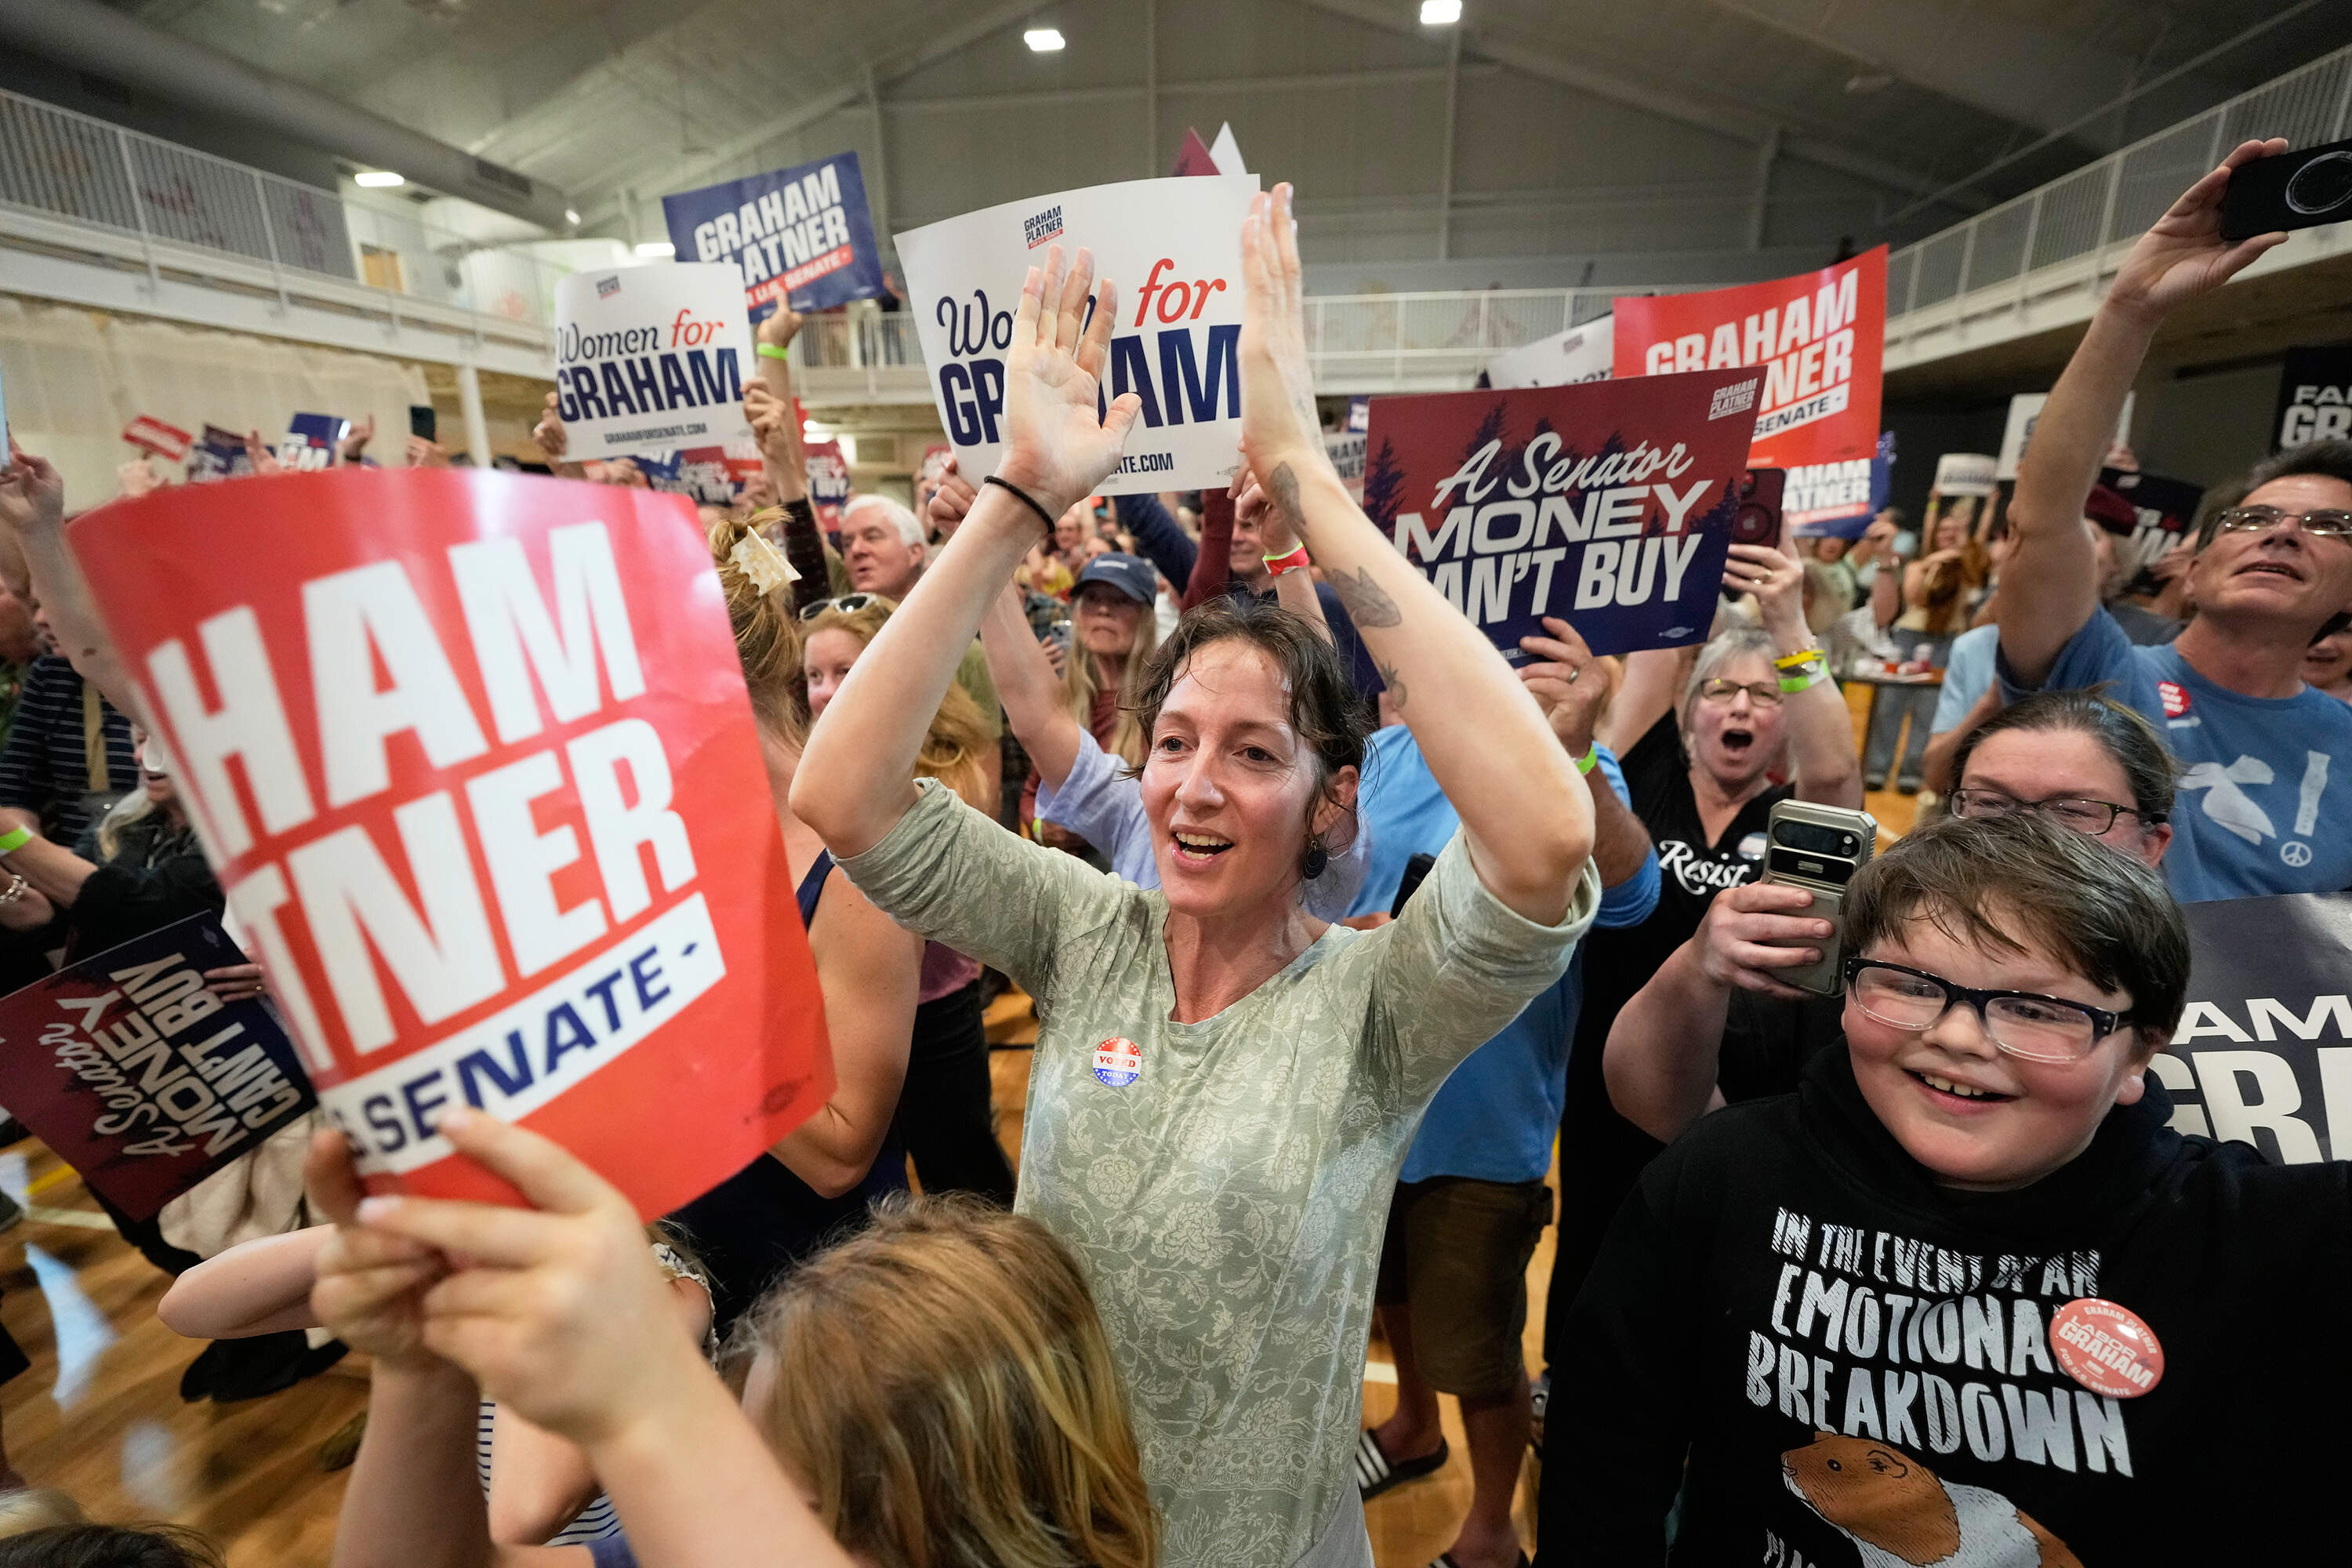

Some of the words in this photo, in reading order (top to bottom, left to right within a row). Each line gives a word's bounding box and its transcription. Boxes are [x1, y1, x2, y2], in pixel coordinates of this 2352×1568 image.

[694, 163, 841, 264] GRAHAM
[721, 205, 850, 287] ATNER
[1024, 205, 1062, 232] GRAHAM
[1026, 217, 1063, 243] PLATNER
[784, 251, 840, 290] SENATE
[1134, 258, 1226, 327] for
[557, 322, 659, 364] Women
[672, 308, 724, 348] for
[1646, 268, 1859, 376] GRAHAM
[557, 348, 743, 423] GRAHAM
[1710, 390, 1755, 413] PLATNER
[1712, 377, 1759, 401] GRAHAM
[1753, 394, 1830, 437] SENATE
[2293, 384, 2352, 405] FA
[1431, 438, 1503, 509] A
[1507, 431, 1694, 498] Senator
[1394, 480, 1714, 562] MONEY
[1573, 533, 1703, 609] BUY
[109, 952, 226, 1039] BUY
[38, 1023, 160, 1135] Senator
[56, 989, 249, 1157] MONEY
[177, 1021, 302, 1130] CAN'T
[363, 945, 672, 1155] SENATE
[1101, 1070, 1129, 1080] TODAY
[122, 1126, 198, 1157] A
[1771, 1206, 1812, 1261] IN
[1820, 1223, 1865, 1278] THE
[1874, 1231, 1984, 1294] EVENT
[2041, 1248, 2101, 1298] AN
[1772, 1261, 2079, 1377] EMOTIONA
[2071, 1315, 2137, 1360] LABOR
[2084, 1306, 2125, 1323] GRAHAM
[2125, 1318, 2158, 1354] PLATNER
[2058, 1321, 2154, 1389] GRAHAM
[2059, 1347, 2074, 1366] FOR
[2090, 1381, 2132, 1396] SENATE
[1746, 1330, 2134, 1479] BREAKDOWN
